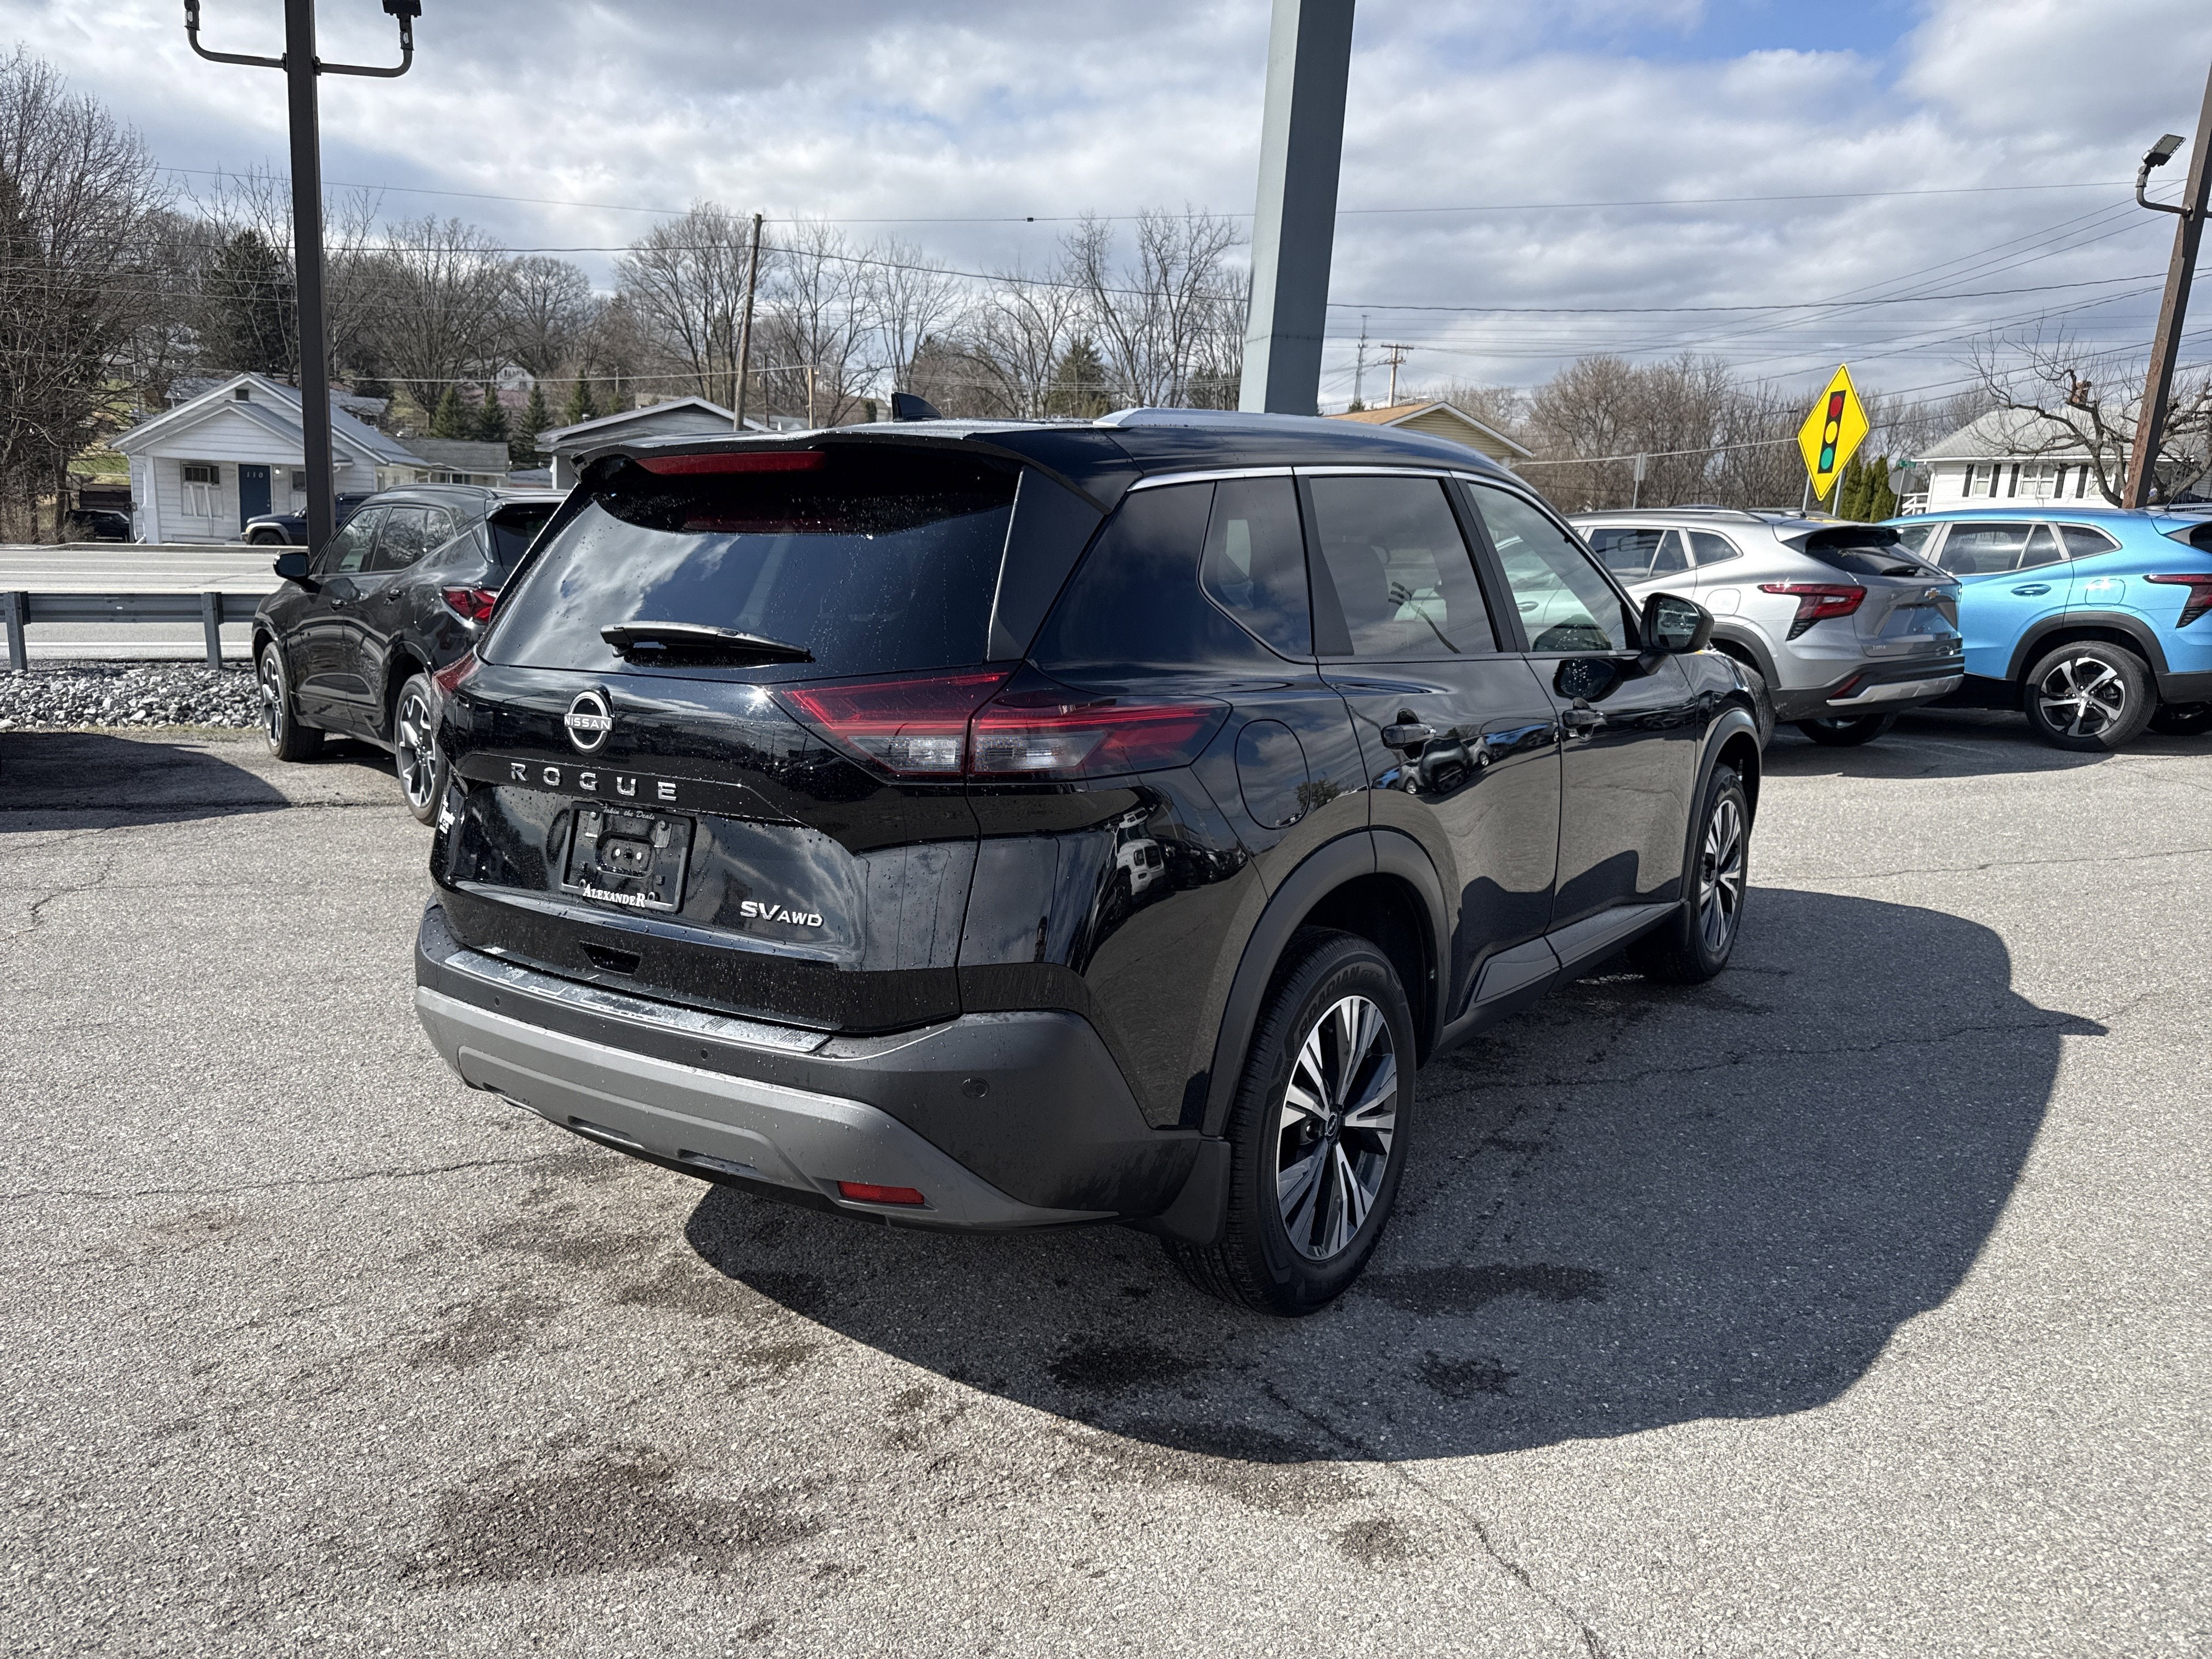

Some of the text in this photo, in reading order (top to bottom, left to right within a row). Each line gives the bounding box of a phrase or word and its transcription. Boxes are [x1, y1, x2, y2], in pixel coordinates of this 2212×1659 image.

[564, 714, 612, 731] NISSAN
[510, 762, 678, 802] ROGUE
[636, 810, 656, 820] Deals
[740, 900, 823, 927] SV AWD
